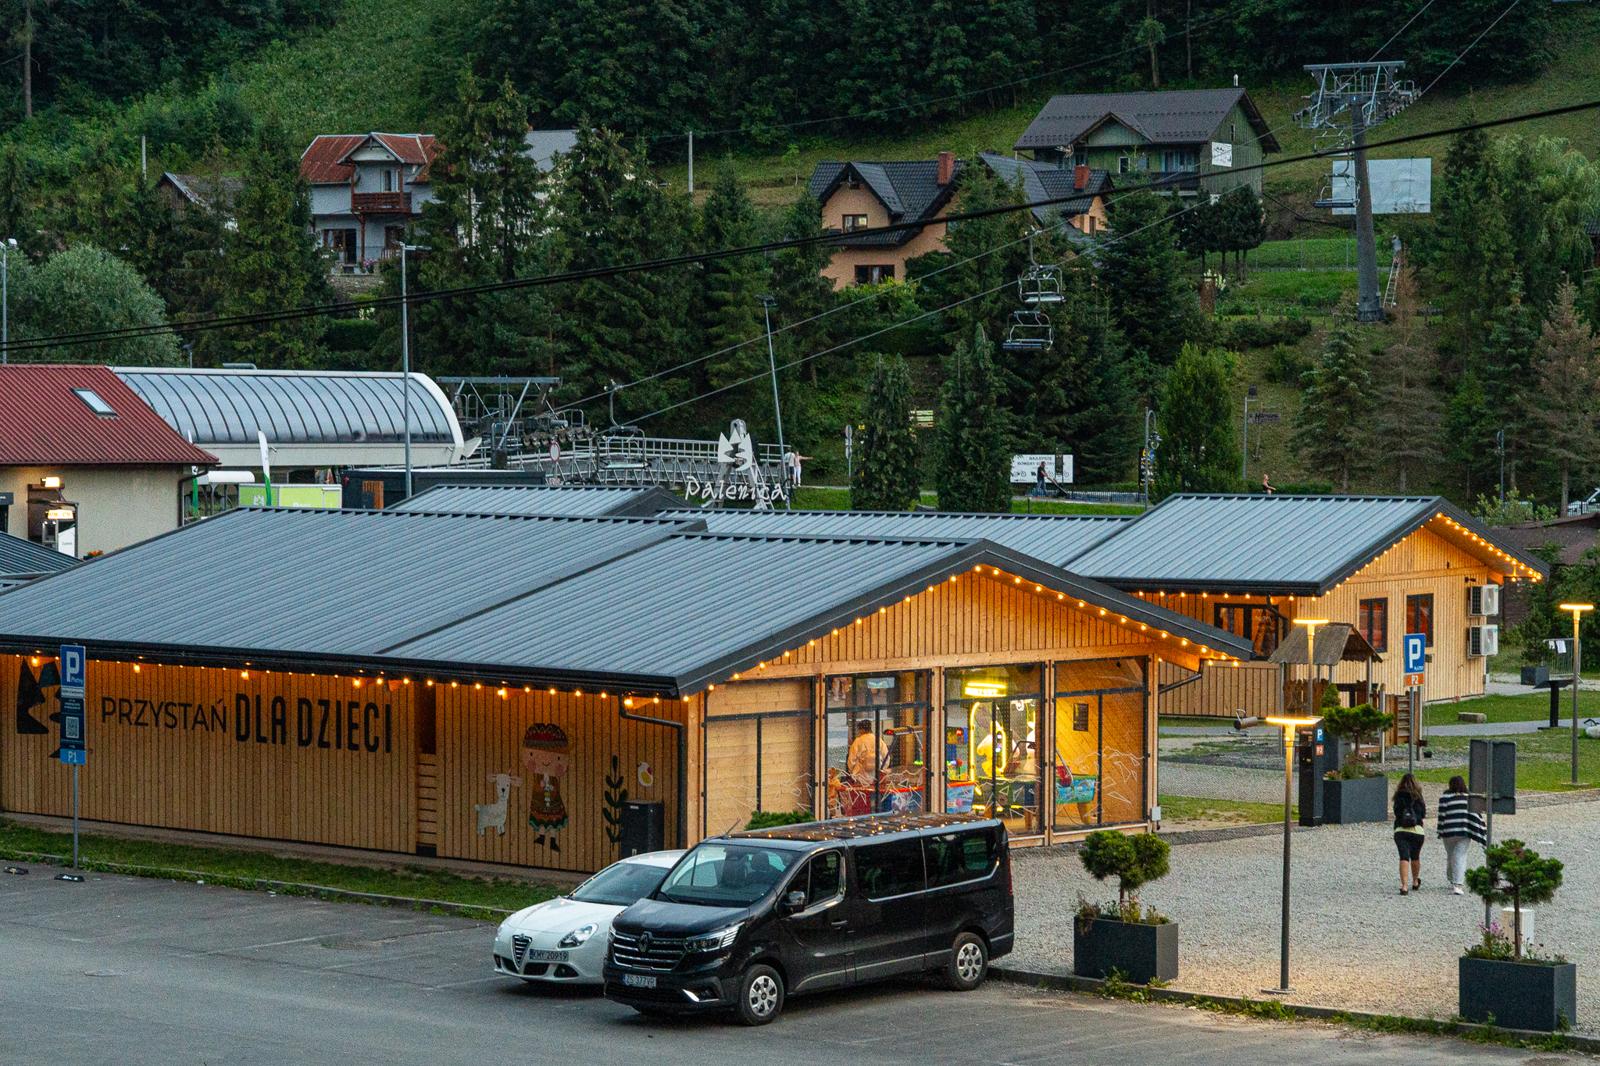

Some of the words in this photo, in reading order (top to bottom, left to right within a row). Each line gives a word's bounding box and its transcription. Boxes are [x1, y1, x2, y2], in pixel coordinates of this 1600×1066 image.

[685, 475, 787, 501] Palenica
[66, 651, 80, 683] P
[1409, 638, 1421, 669] P
[1411, 674, 1419, 685] P2
[101, 696, 227, 733] PRZYSTAŃ
[235, 693, 287, 745] DLA
[297, 697, 392, 753] DZIECI
[68, 751, 77, 763] P1
